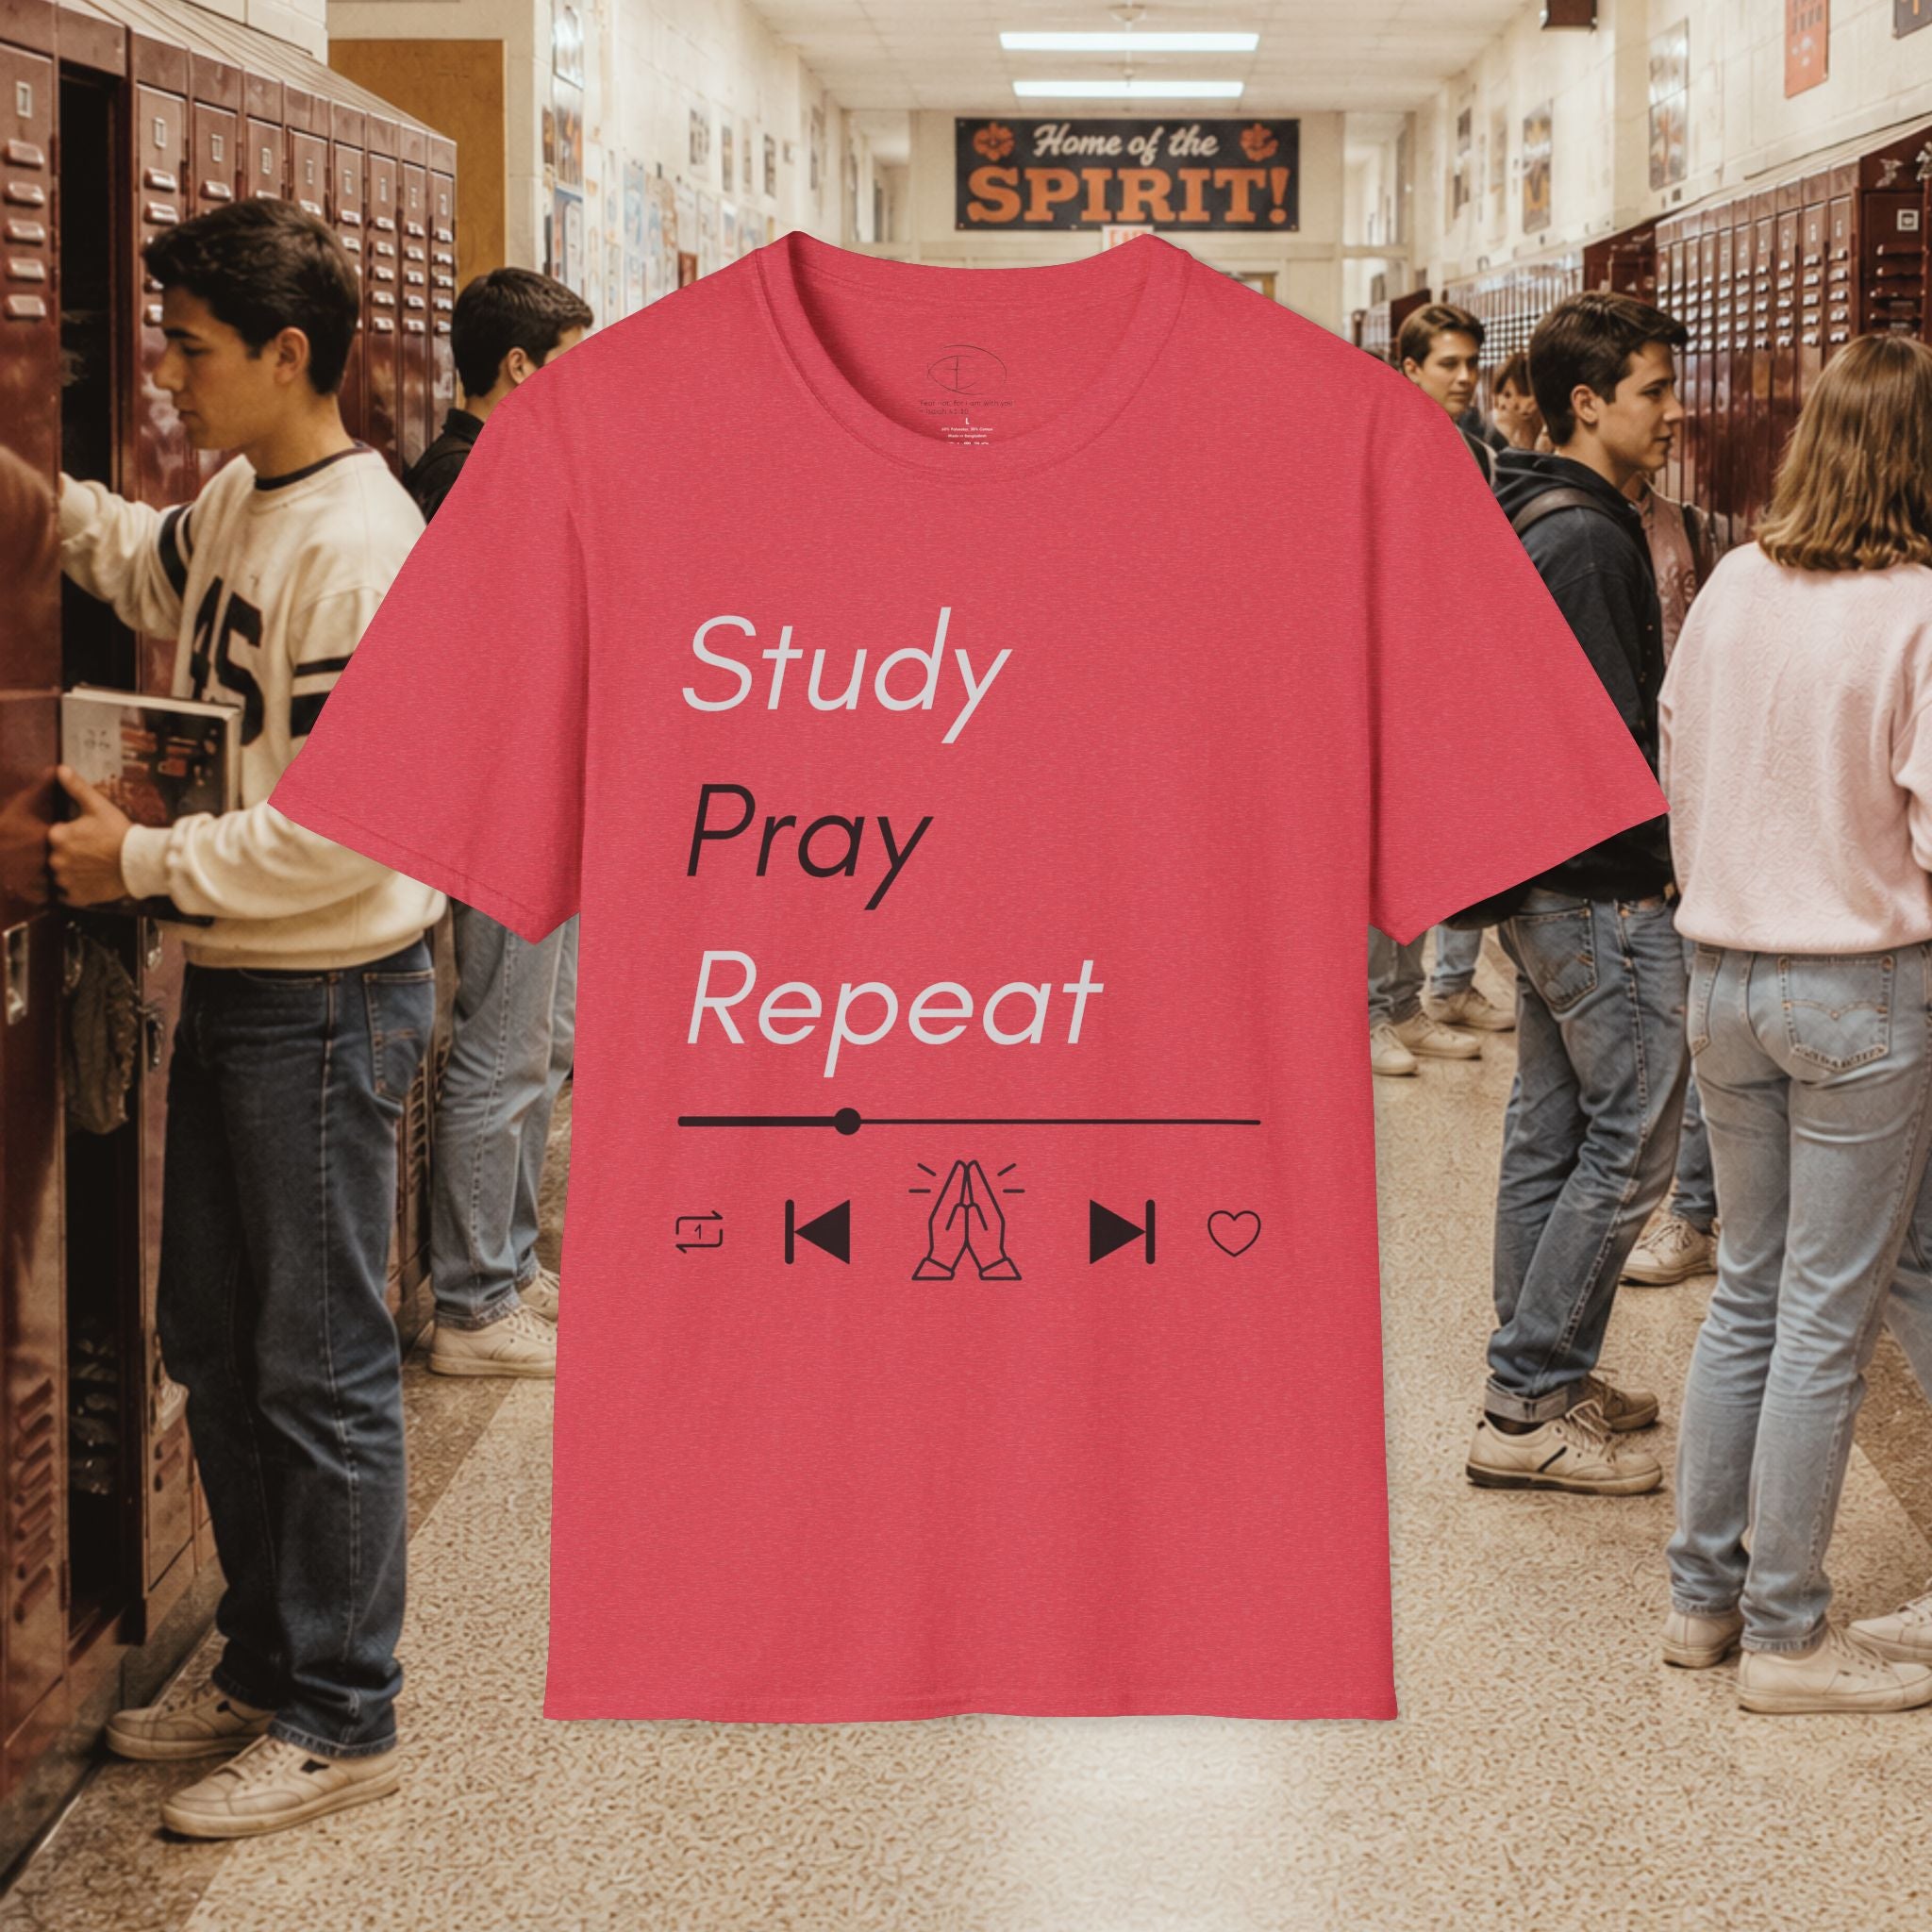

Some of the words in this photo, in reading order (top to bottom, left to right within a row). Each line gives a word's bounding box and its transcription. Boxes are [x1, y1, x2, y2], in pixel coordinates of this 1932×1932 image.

[1033, 124, 1123, 157] Home
[1126, 126, 1165, 167] of
[1167, 125, 1220, 157] the
[966, 165, 1290, 224] SPIRIT!
[965, 417, 970, 425] L
[682, 607, 1013, 744] Study
[687, 783, 934, 911] Pray
[687, 950, 1105, 1078] Repeat
[694, 1224, 702, 1240] 1
